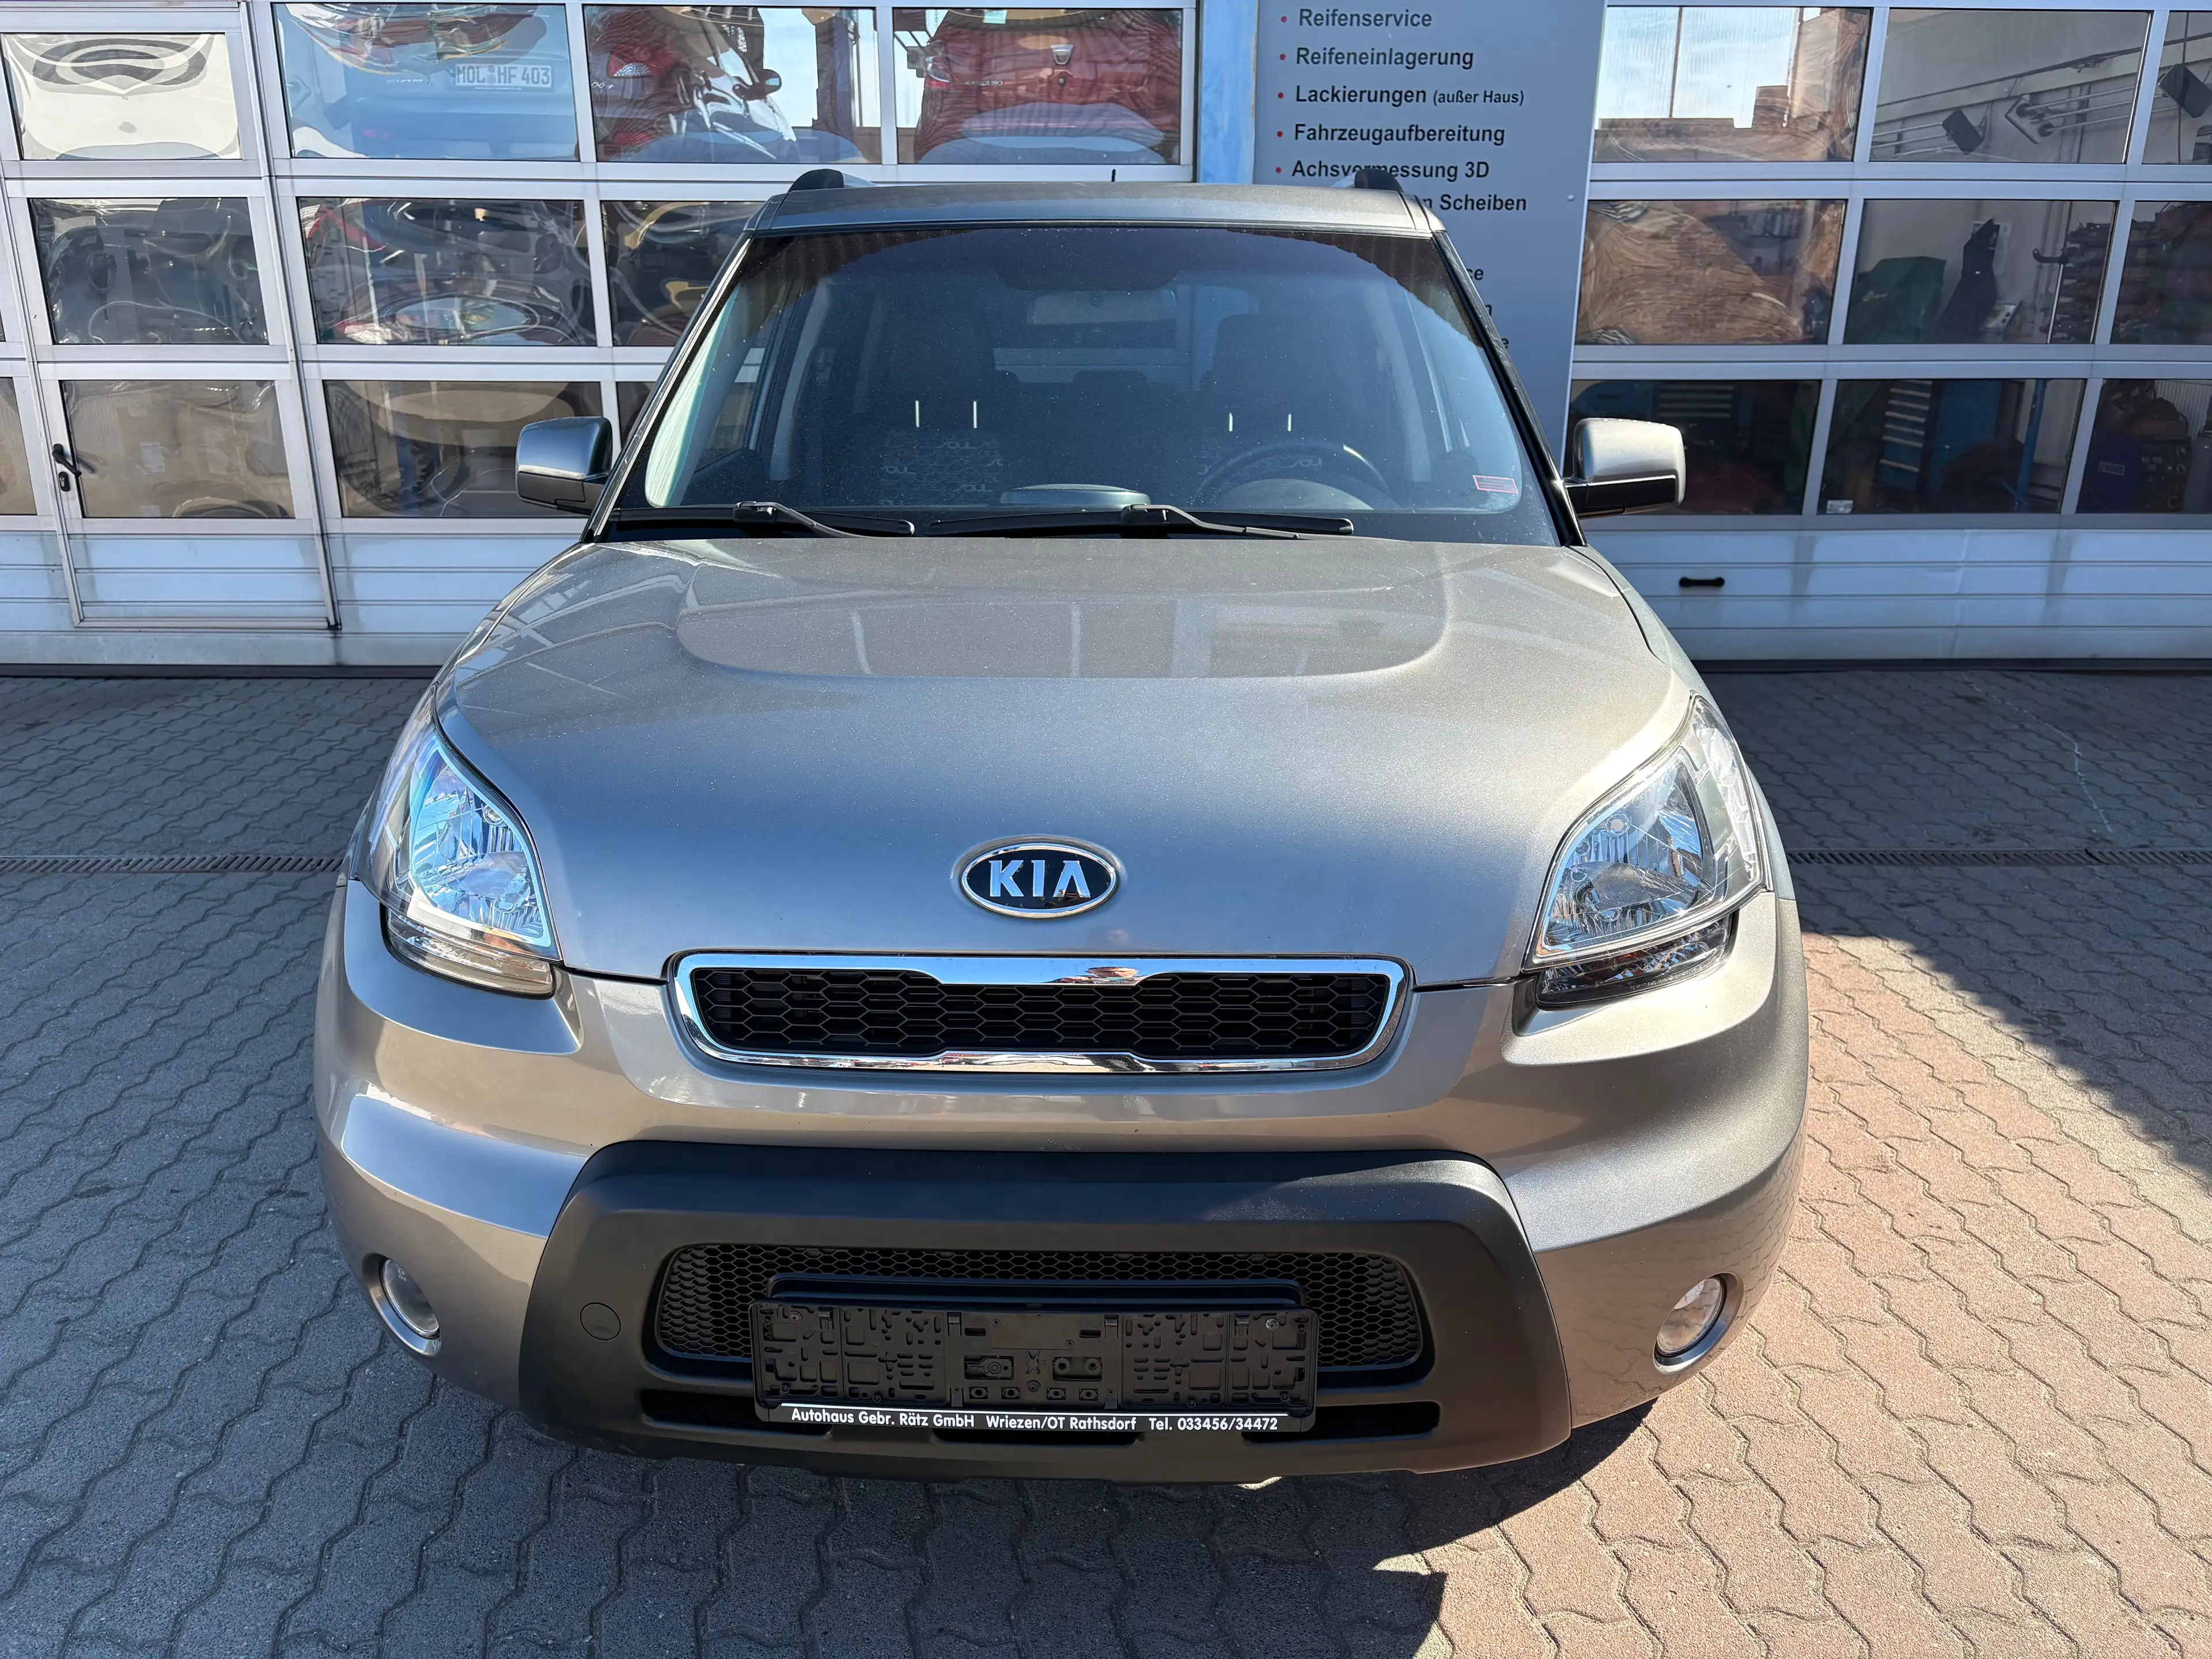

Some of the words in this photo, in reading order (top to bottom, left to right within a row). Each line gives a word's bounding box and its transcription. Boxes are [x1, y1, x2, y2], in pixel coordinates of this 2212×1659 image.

[1299, 8, 1433, 27] Reifenservice
[1296, 47, 1474, 70] Reifeneinlagerung
[456, 65, 486, 84] MOL
[497, 67, 517, 85] HF
[521, 67, 550, 85] 403
[1295, 85, 1427, 108] Lackierungen
[1433, 89, 1479, 107] (außer
[1483, 89, 1525, 107] Haus)
[1294, 124, 1506, 147] Fahrzeugaufbereitung
[1291, 160, 1459, 183] Achsveessung
[1464, 160, 1490, 179] 3D
[1440, 194, 1527, 211] Scheiben
[988, 859, 1091, 898] KIA
[791, 1407, 855, 1423] Autohaus
[858, 1411, 895, 1426] Gebr.
[899, 1411, 929, 1427] Rätz
[933, 1414, 975, 1428] GmbH
[986, 1415, 1065, 1430] Wriezen/OT
[1070, 1416, 1138, 1431] Rathsdorf
[1148, 1417, 1173, 1431] Tel.
[1177, 1418, 1278, 1431] 033456/34472
